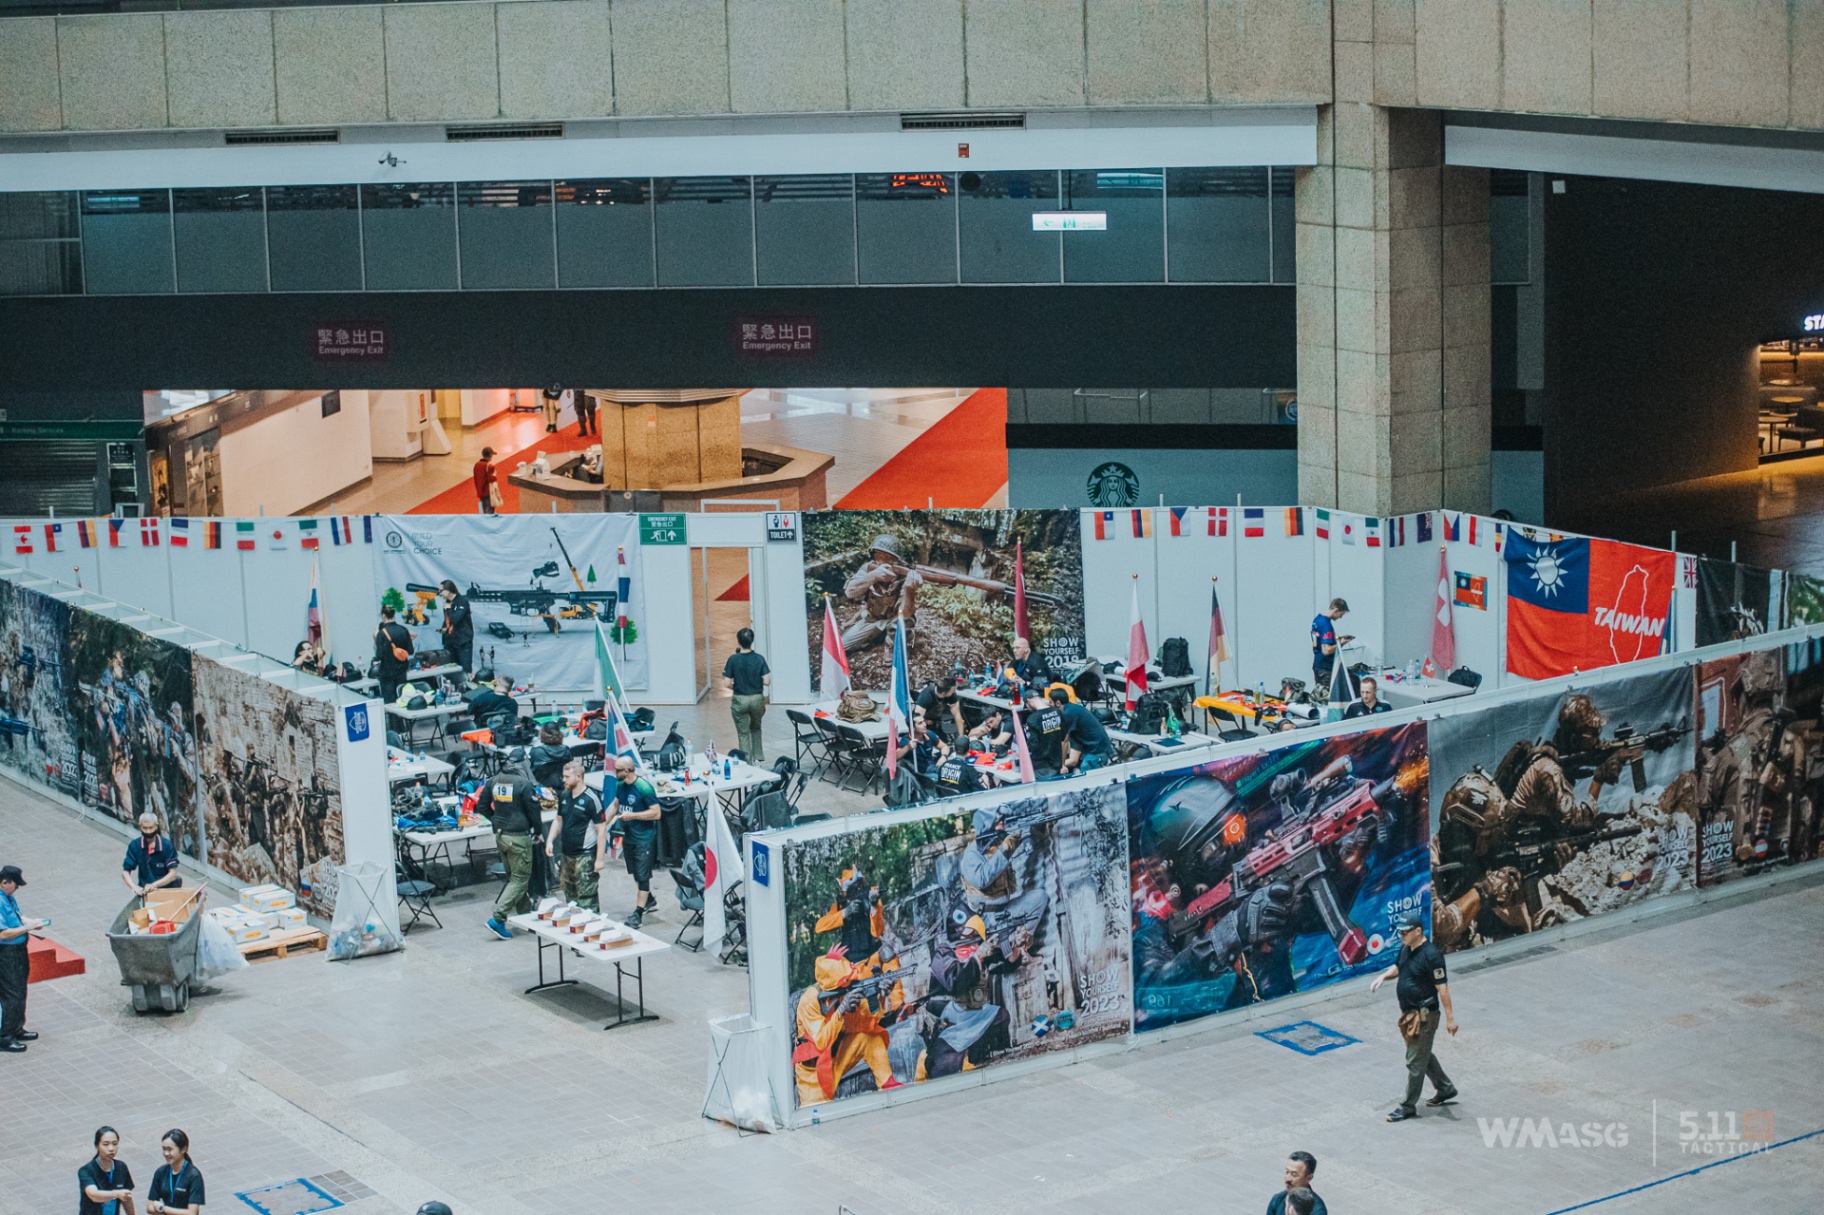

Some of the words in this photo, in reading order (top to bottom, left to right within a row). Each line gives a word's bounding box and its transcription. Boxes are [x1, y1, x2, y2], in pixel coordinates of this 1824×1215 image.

[318, 329, 383, 345] 緊急出口
[742, 324, 811, 339] 緊急出口
[318, 346, 365, 356] Emergency
[367, 346, 383, 354] Exit
[743, 342, 792, 351] Emergency
[412, 532, 432, 540] BUILD
[770, 531, 787, 539] TOILET
[413, 547, 442, 555] CHOICE
[1594, 606, 1666, 637] TAIWAN
[1043, 637, 1079, 648] SHOW
[1044, 647, 1080, 656] YOURSELF
[497, 785, 507, 796] 19
[1702, 820, 1734, 838] SHOW
[1702, 832, 1733, 848] YOURSELF
[1659, 849, 1690, 869] 2023
[1700, 842, 1733, 864] 2023
[1387, 893, 1422, 914] SHOW
[1080, 966, 1120, 988] SHOW
[1080, 981, 1120, 999] YOURSELF
[1081, 993, 1121, 1018] 2023
